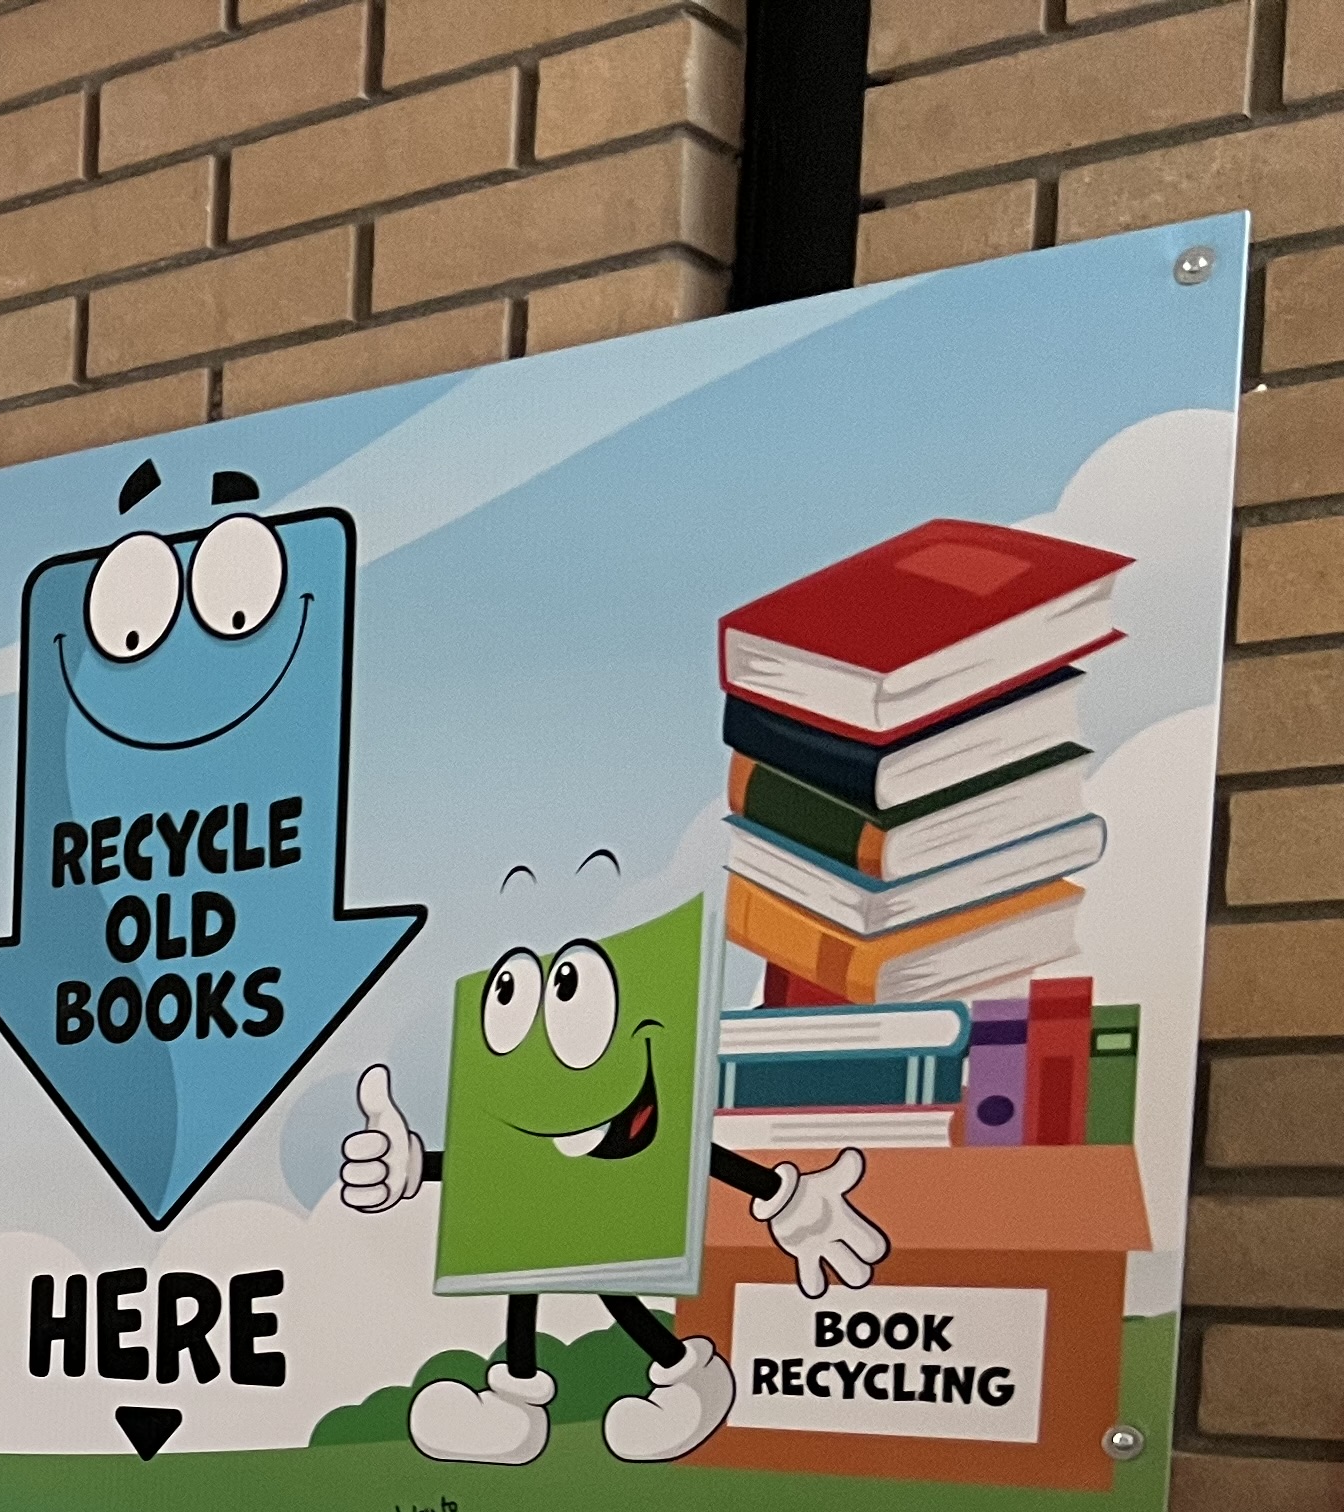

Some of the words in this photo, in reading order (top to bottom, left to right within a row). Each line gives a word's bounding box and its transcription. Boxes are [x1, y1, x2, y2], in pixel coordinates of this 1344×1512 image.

[51, 796, 303, 888] RECYCLE
[104, 891, 237, 963] OLD
[55, 966, 286, 1045] BOOKS
[28, 1266, 288, 1388] HERE
[814, 1311, 954, 1352] BOOK
[752, 1357, 1015, 1407] RECYCLING
